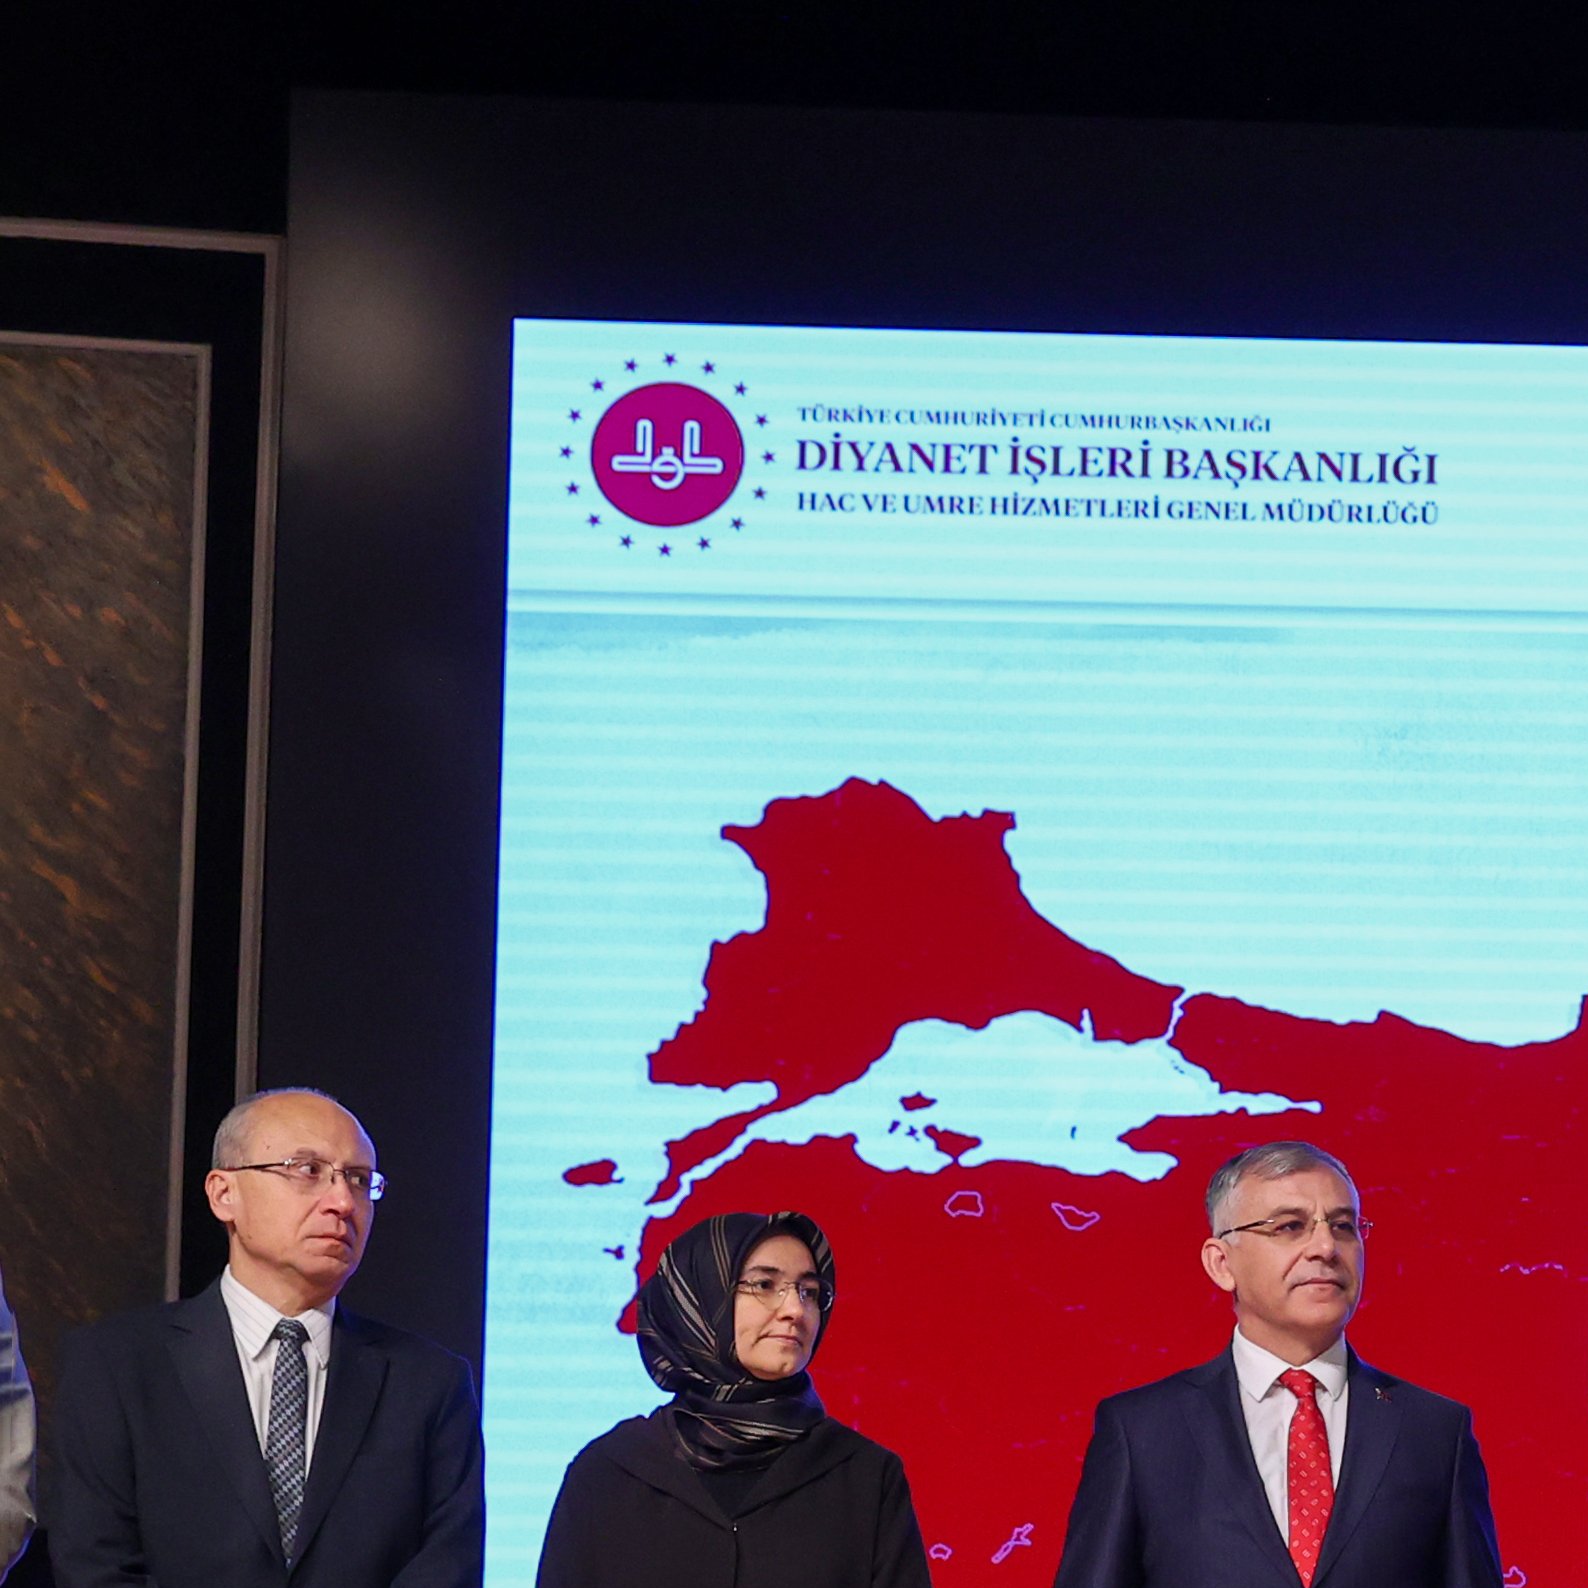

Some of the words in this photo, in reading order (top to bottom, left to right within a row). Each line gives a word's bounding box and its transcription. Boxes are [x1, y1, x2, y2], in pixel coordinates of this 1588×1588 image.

[797, 403, 891, 424] TÜRKİYE
[894, 407, 1046, 428] CUMHURİYETİ
[1049, 412, 1271, 434] CUMHURBAŞKANLIĞI
[795, 432, 999, 475] DİYANET
[1007, 436, 1153, 486] İŞLERİ
[1163, 445, 1439, 489] BAŞKANLIĞI
[797, 492, 856, 513] HAC
[861, 493, 897, 514] VE
[903, 494, 984, 516] UMRE
[989, 491, 1160, 520] HİZMETLERİ
[1166, 500, 1257, 522] GENEL
[1261, 498, 1440, 525] MÜDÜRLÜĞÜ
